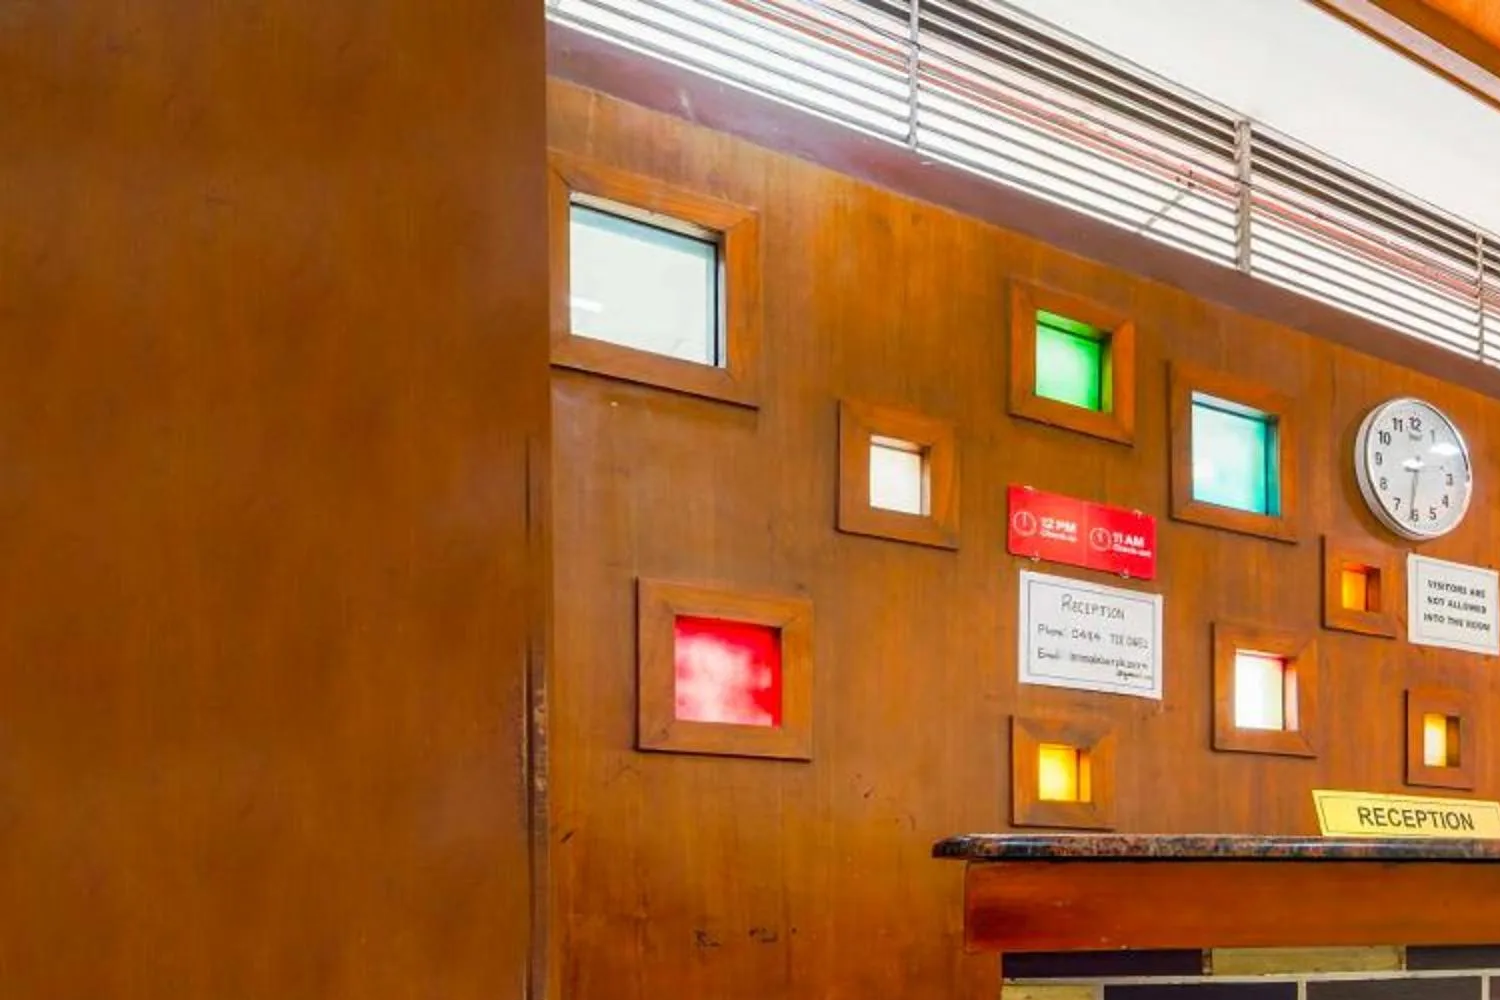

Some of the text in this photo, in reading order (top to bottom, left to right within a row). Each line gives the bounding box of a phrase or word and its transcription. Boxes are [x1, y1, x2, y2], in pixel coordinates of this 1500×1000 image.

[1392, 417, 1403, 432] 11
[1409, 417, 1421, 432] 12
[1378, 430, 1392, 446] 10
[1375, 452, 1383, 466] 9
[1380, 477, 1388, 490] 8
[1445, 473, 1453, 486] 3
[1393, 497, 1401, 510] 7
[1442, 494, 1449, 508] 4
[1429, 506, 1437, 520] 5
[1055, 519, 1077, 533] PM
[1124, 534, 1145, 548] AM
[1427, 579, 1485, 599] VISITORS ARE
[1447, 616, 1463, 628] THE
[1357, 806, 1475, 830] RECEPTION
